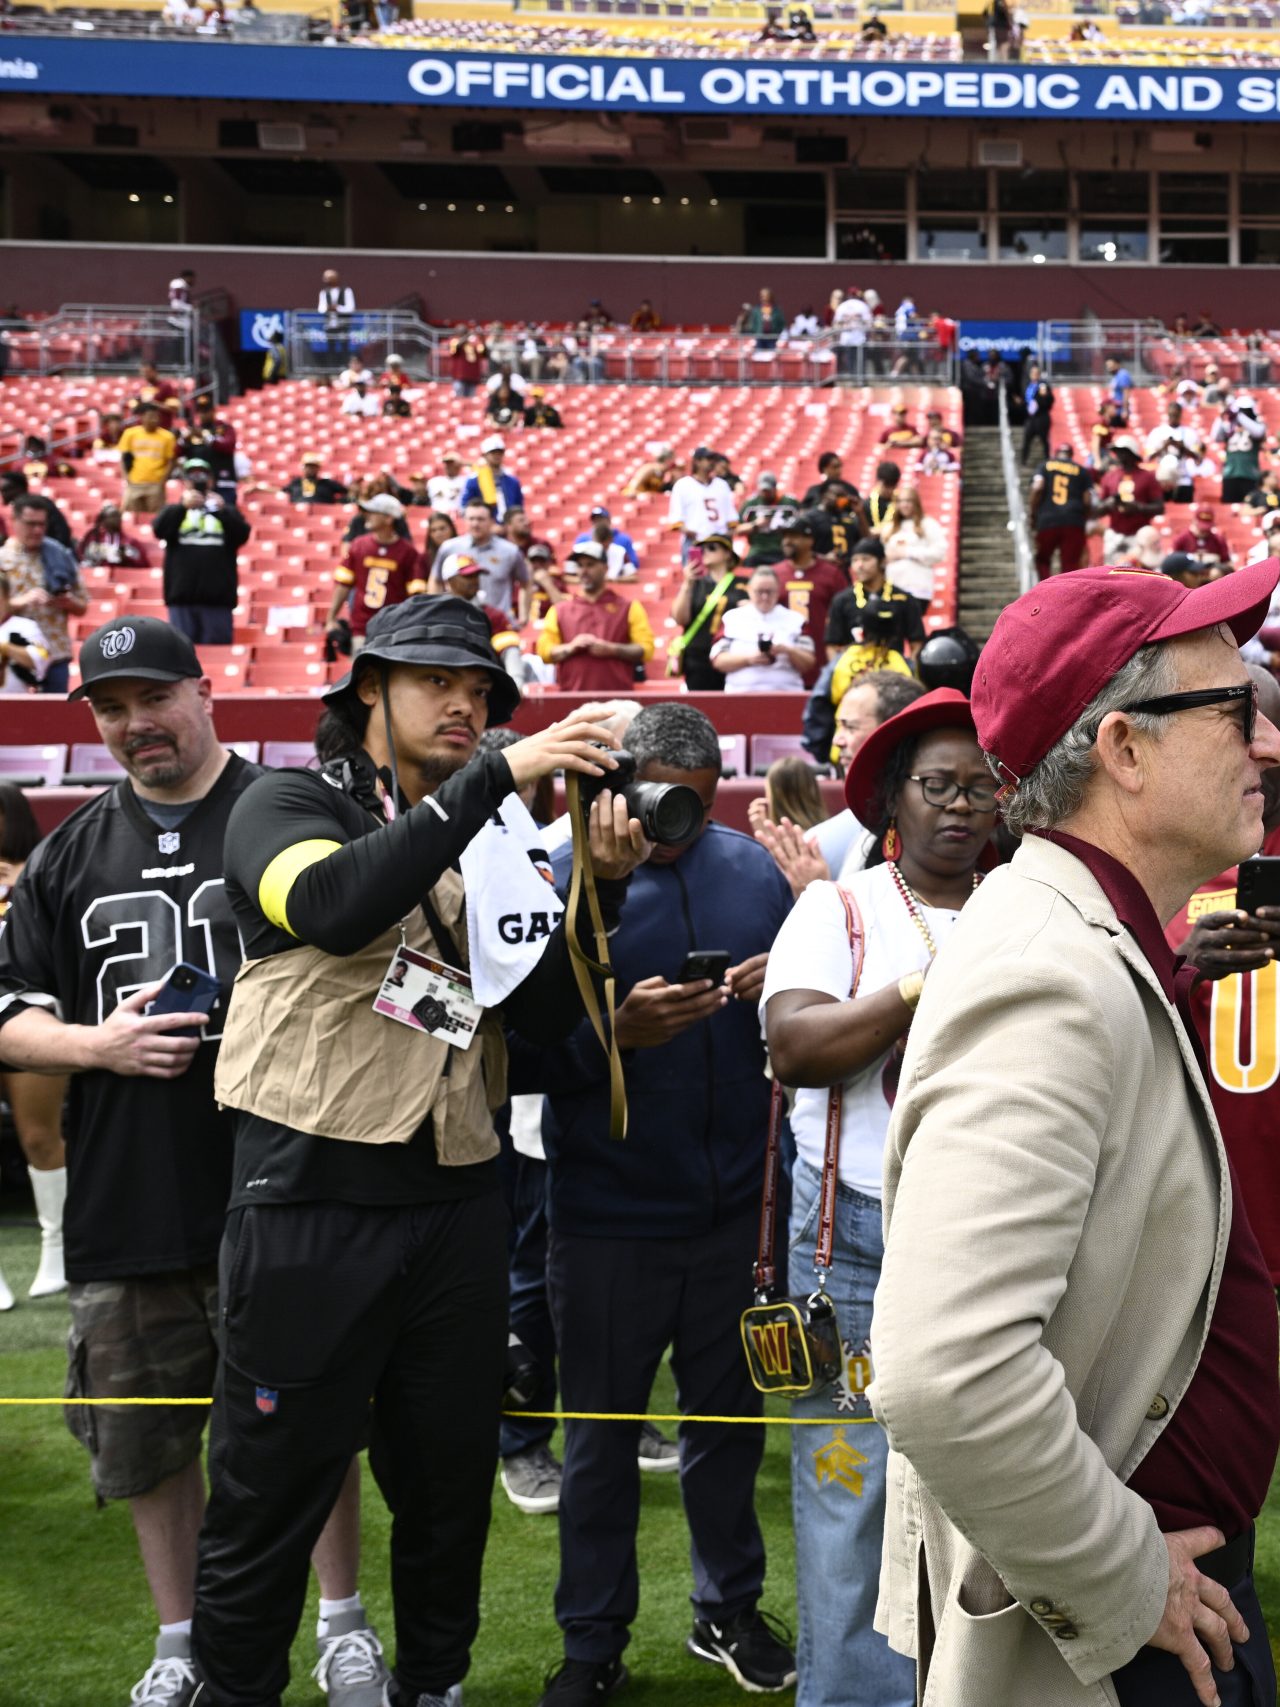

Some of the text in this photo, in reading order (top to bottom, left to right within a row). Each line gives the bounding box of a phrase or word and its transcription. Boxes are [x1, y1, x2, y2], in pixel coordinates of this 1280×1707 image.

[408, 58, 686, 103] OFFICIAL
[700, 68, 1080, 110] ORTHOPEDIC
[1095, 74, 1223, 111] AND
[703, 498, 719, 521] 5
[1051, 474, 1069, 505] 5
[364, 567, 389, 609] 5
[751, 1322, 793, 1376] W
